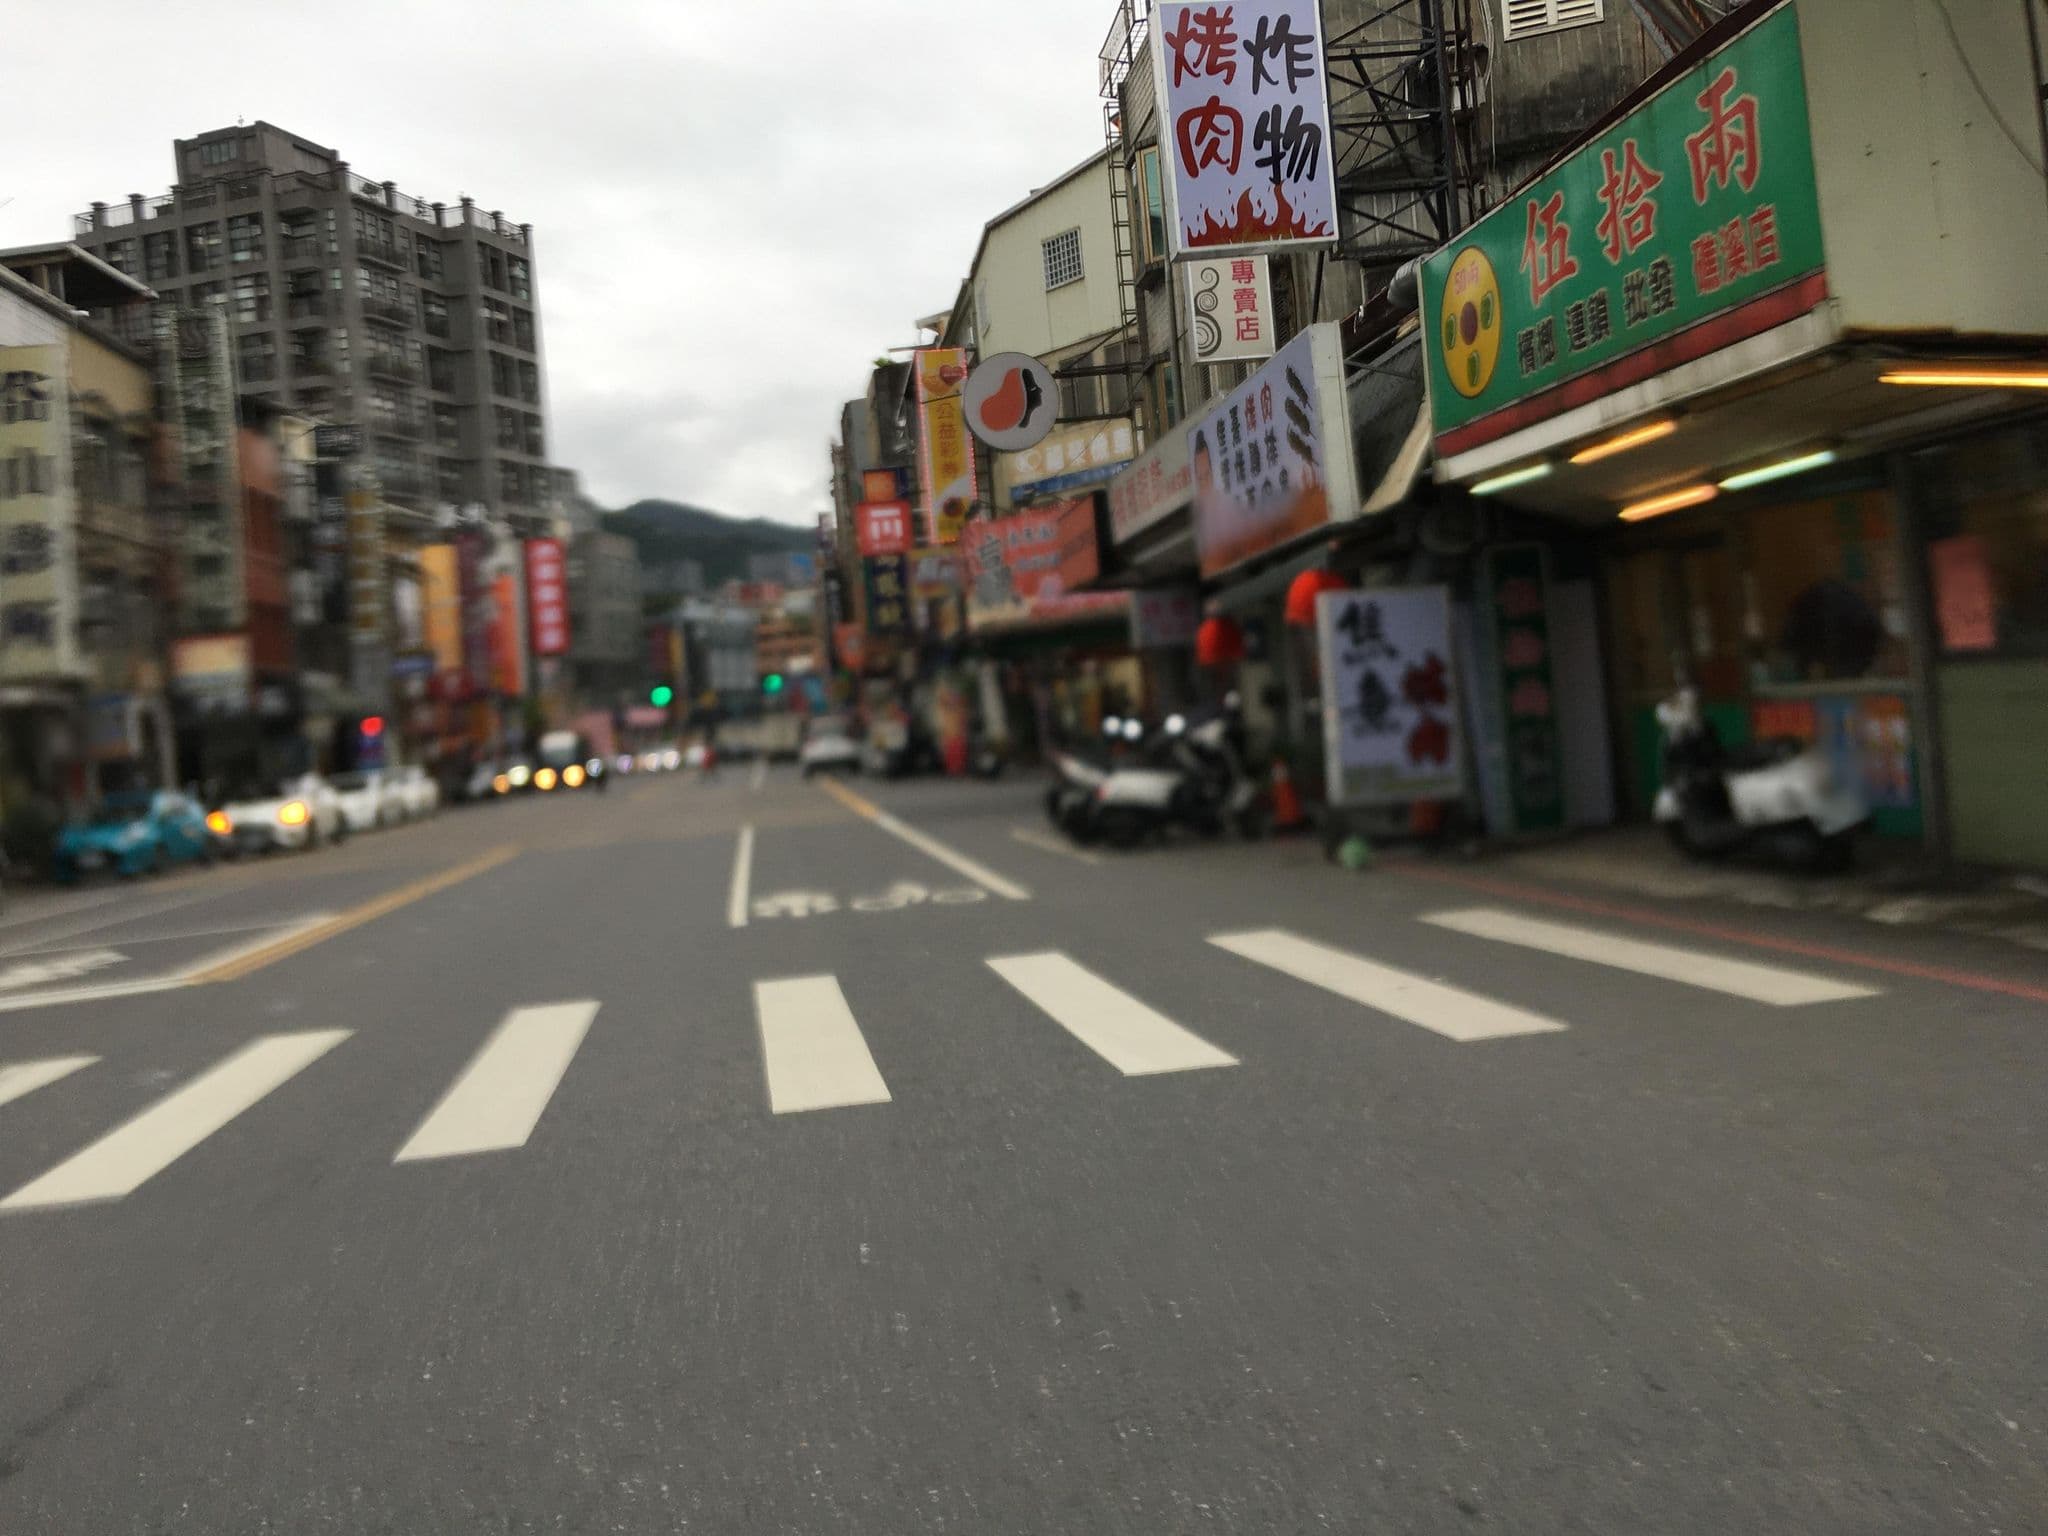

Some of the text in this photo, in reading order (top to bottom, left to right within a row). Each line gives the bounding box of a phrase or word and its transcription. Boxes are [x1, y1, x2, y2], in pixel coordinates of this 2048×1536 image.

[1164, 5, 1243, 178] 烤肉
[1243, 14, 1322, 185] 炸物
[1520, 66, 1760, 306] 伍拾兩
[1230, 259, 1260, 343] 專賣店
[1623, 255, 1678, 329] 批發
